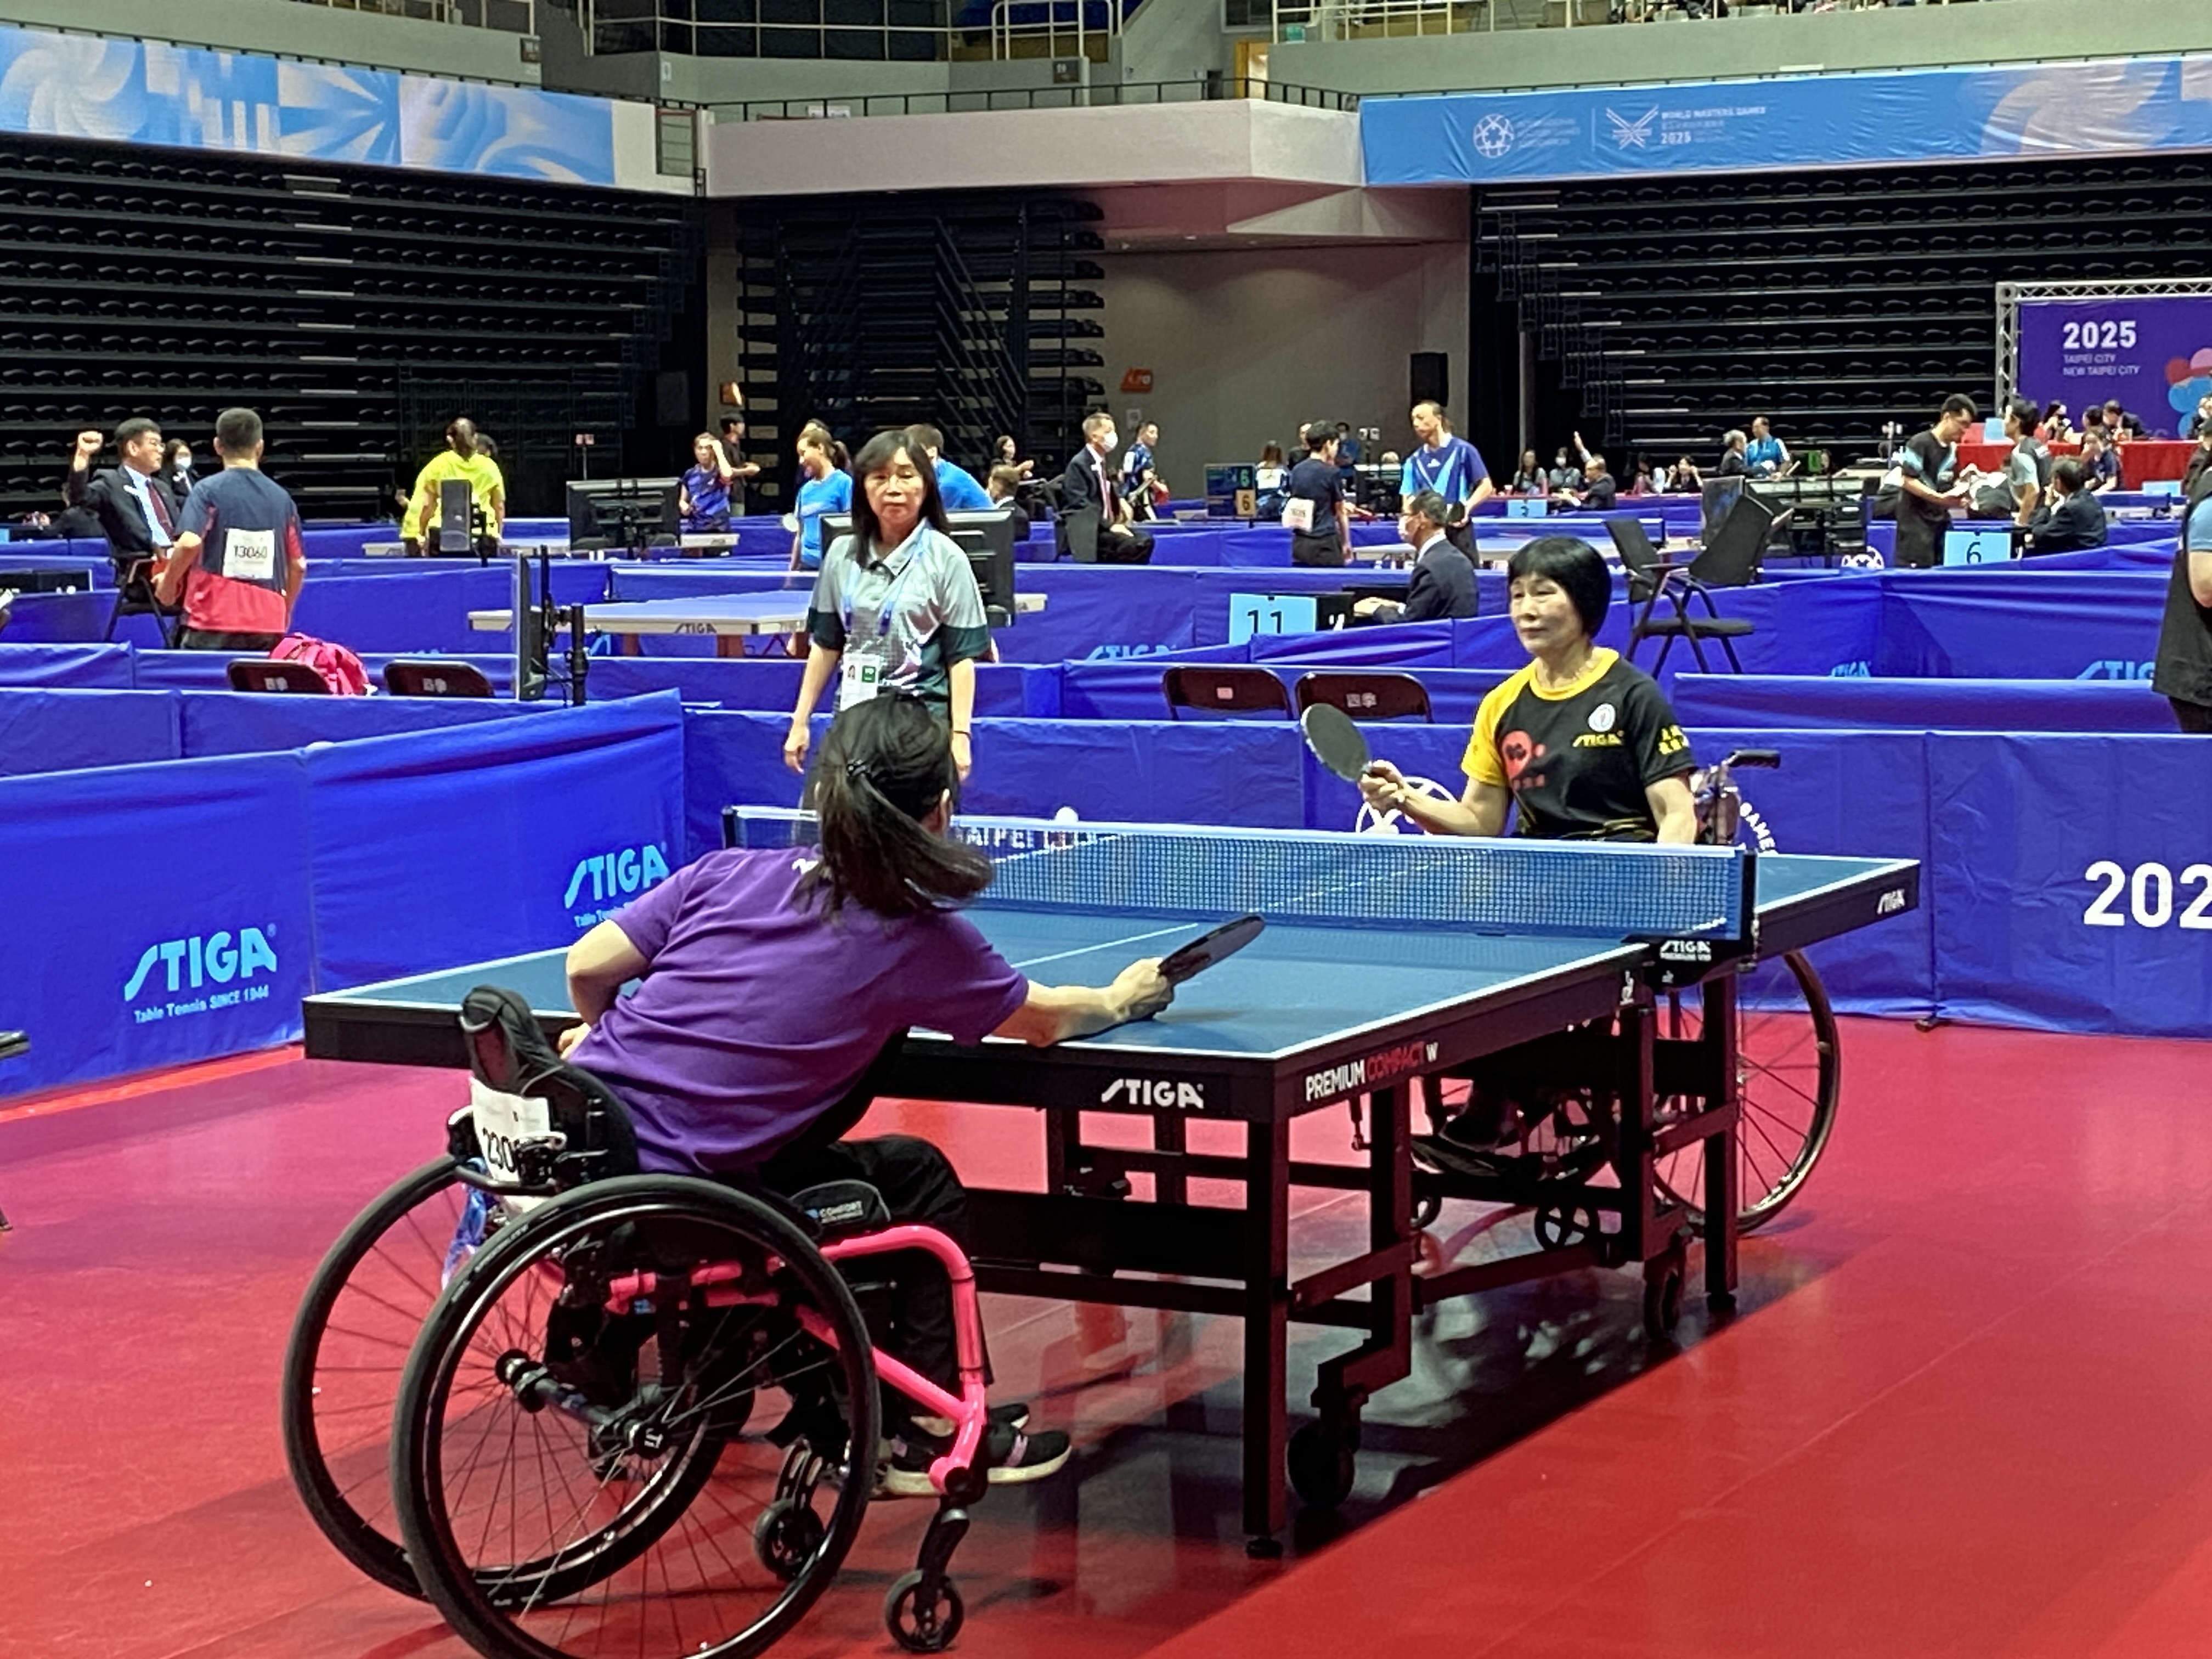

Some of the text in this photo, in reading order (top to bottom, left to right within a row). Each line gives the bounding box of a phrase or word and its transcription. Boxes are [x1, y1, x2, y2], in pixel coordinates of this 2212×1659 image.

[1661, 131, 1691, 145] 2025
[2063, 320, 2136, 349] 2025
[2064, 354, 2116, 364] TAIPEI CITY
[2063, 365, 2140, 376] NEW TAIPEI CITY
[1240, 469, 1250, 487] 6
[1242, 494, 1250, 511] 6
[1967, 542, 1982, 564] 6
[674, 622, 717, 634] STIGA
[1248, 610, 1283, 633] 11
[2076, 661, 2155, 680] STIG
[1572, 733, 1623, 747] STIGA
[1740, 802, 1778, 852] GAME
[564, 845, 670, 909] STIGA
[1660, 940, 1712, 953] STIGA
[124, 927, 277, 1002] STIGA
[134, 984, 269, 1023] Table Tennis SINCE 1944
[1305, 1041, 1438, 1102] PREMIUM COMPACT W
[1101, 1079, 1204, 1109] STIGA
[819, 1200, 862, 1218] COMFORT
